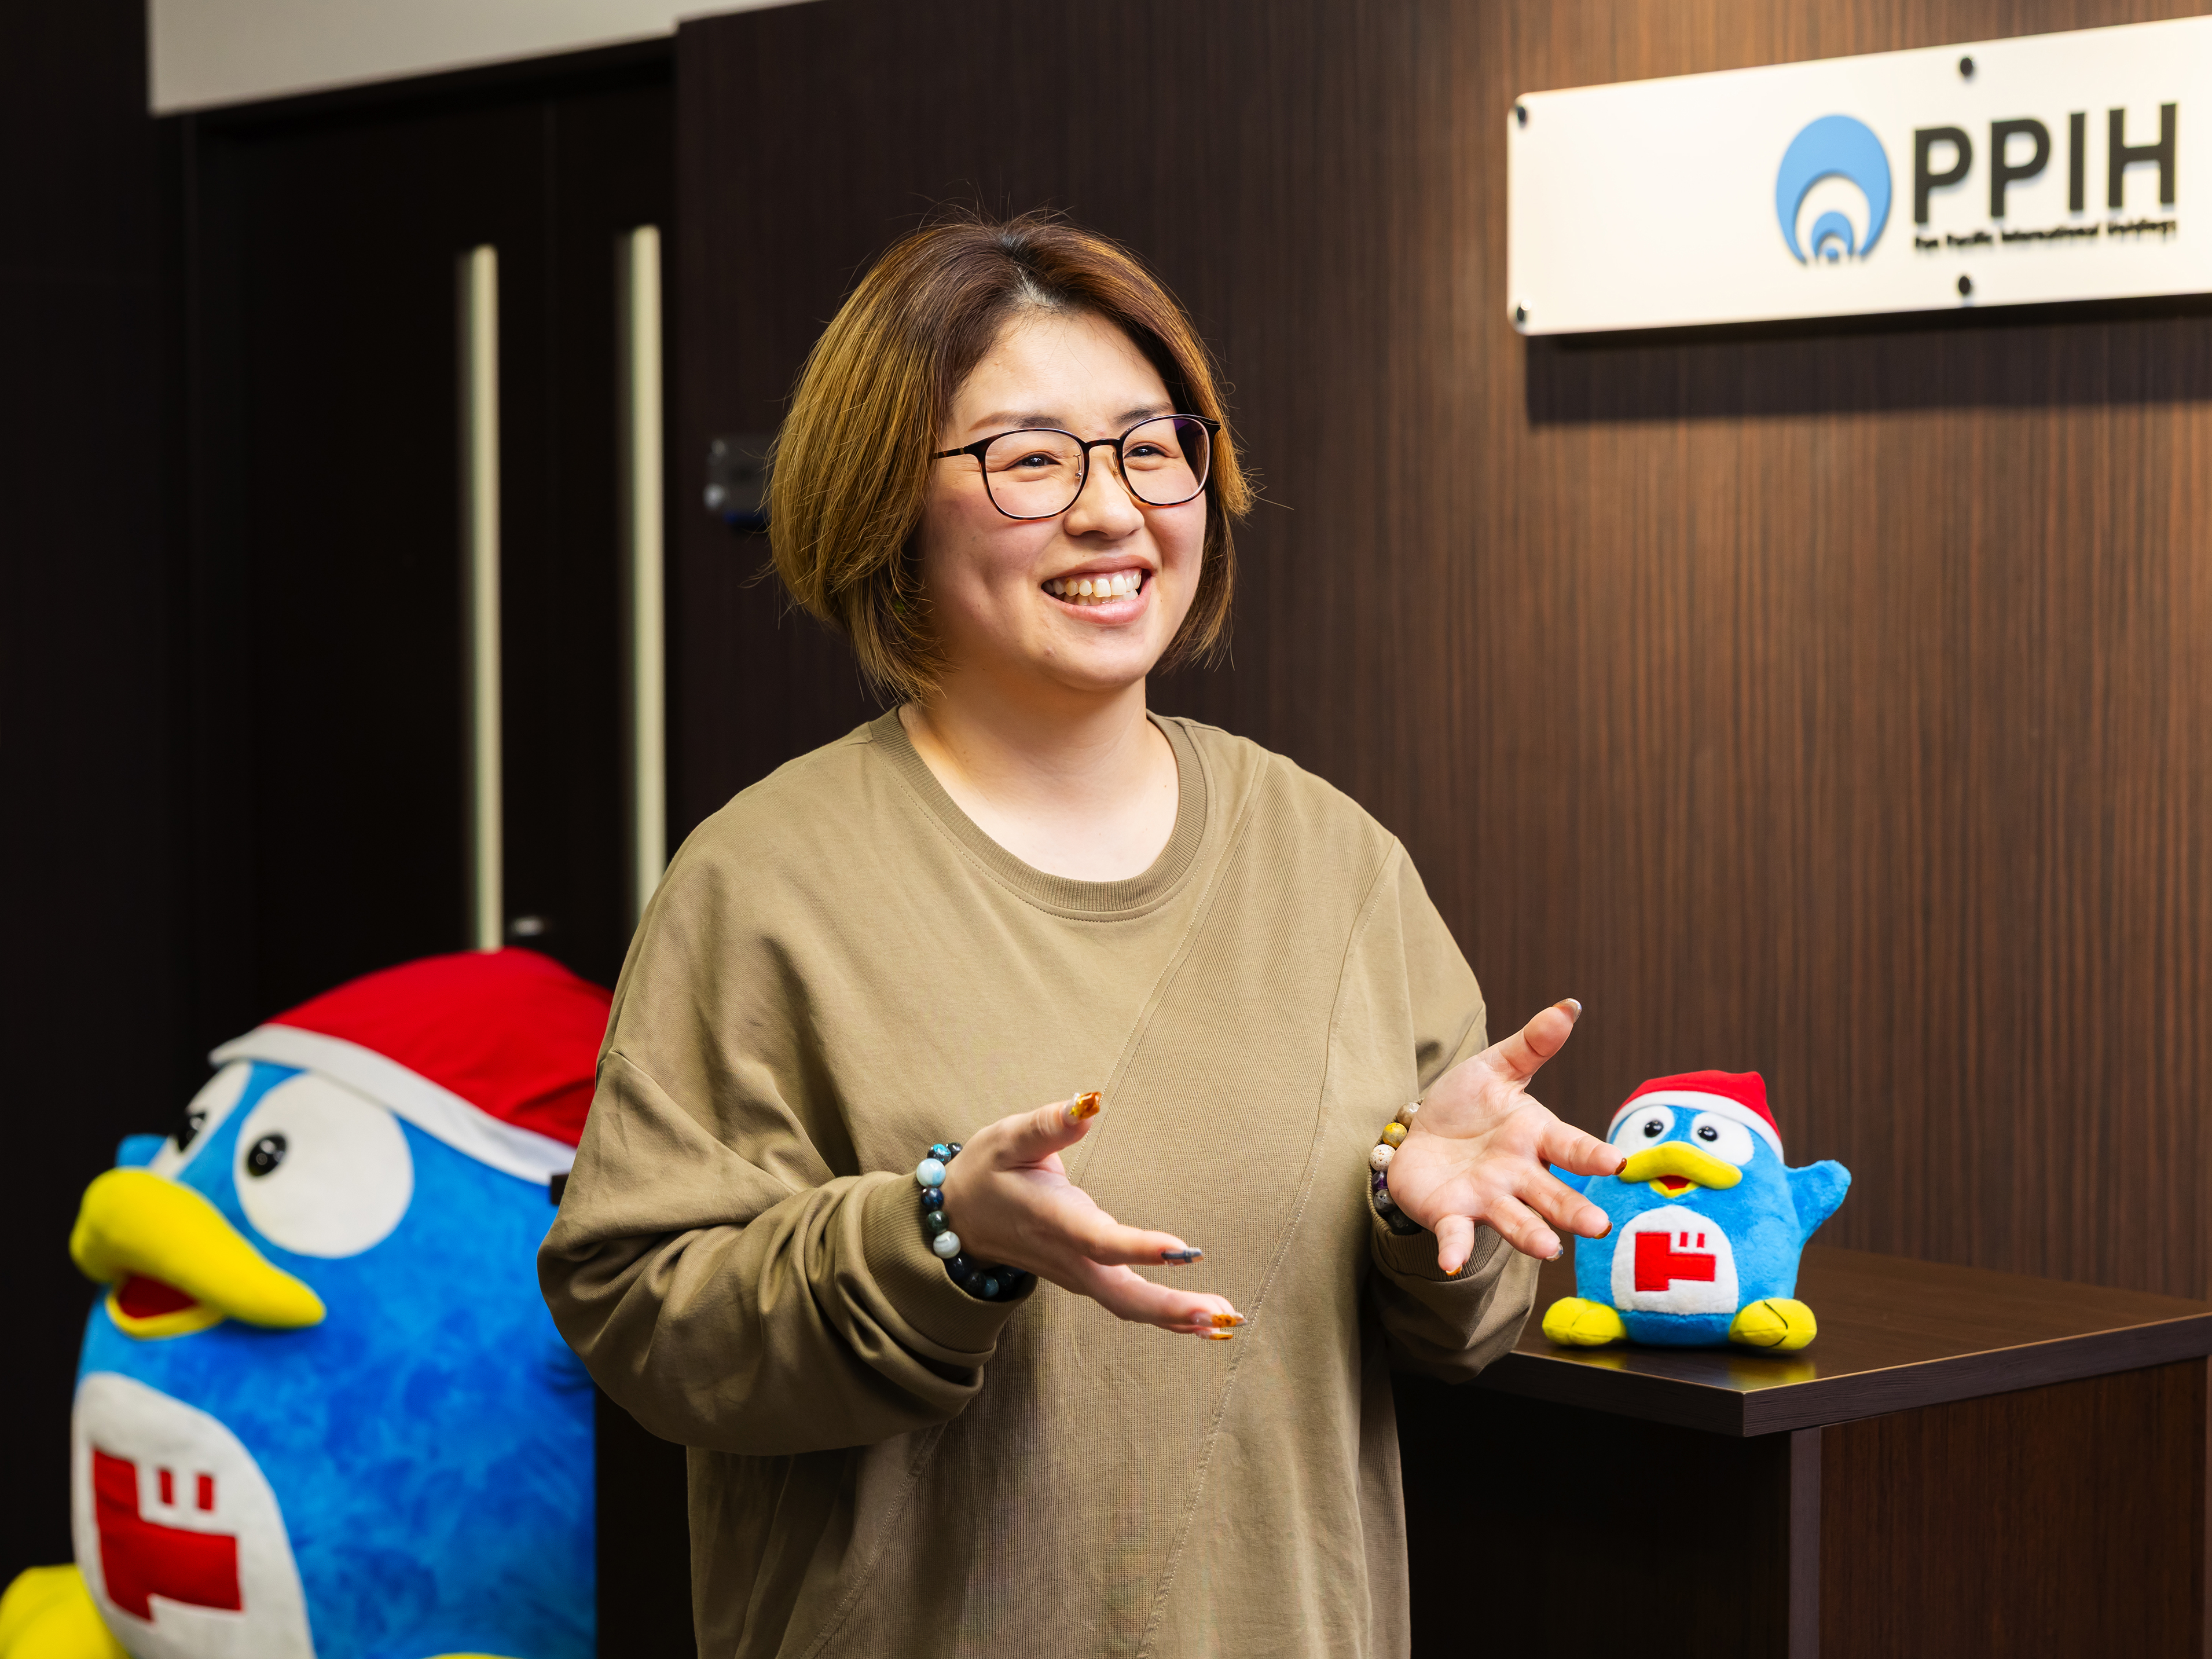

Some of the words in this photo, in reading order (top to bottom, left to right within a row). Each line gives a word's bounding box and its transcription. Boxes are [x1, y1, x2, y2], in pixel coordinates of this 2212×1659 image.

[1914, 103, 2177, 223] PPIH
[1634, 1231, 1716, 1292] ド
[93, 1448, 244, 1623] ド
